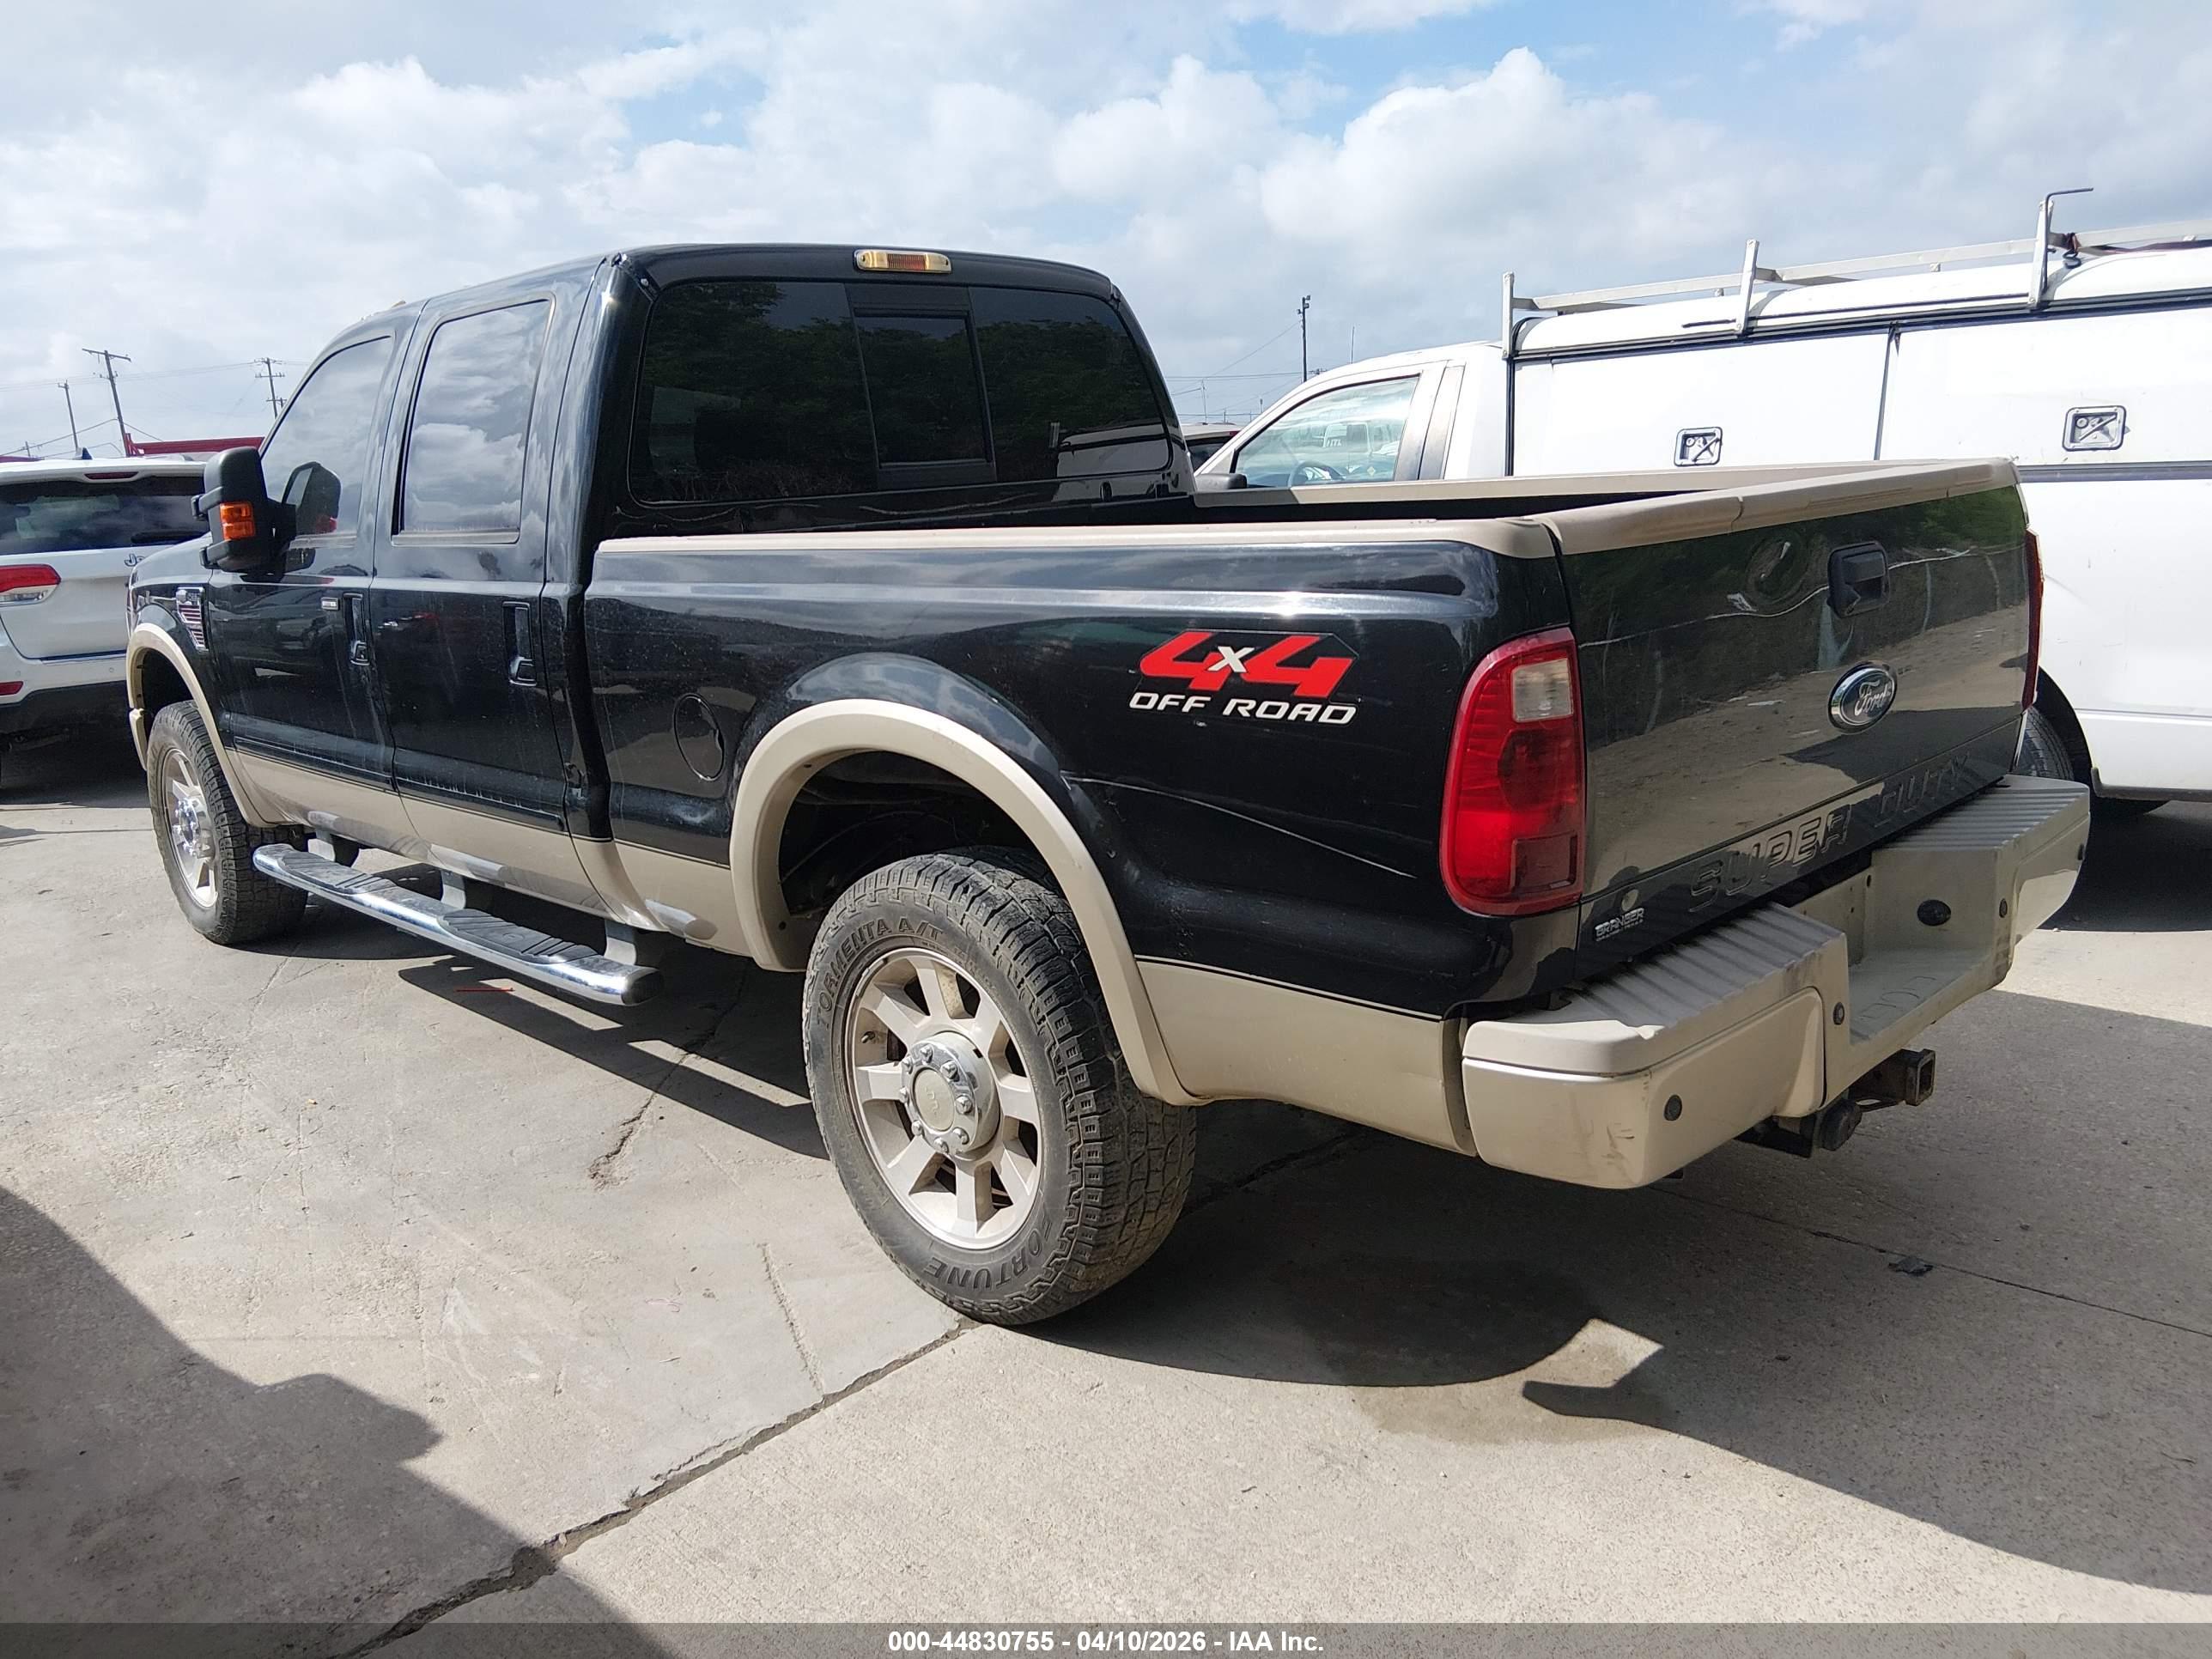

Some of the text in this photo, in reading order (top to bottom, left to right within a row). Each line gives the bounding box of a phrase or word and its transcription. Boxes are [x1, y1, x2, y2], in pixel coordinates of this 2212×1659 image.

[1128, 692, 1357, 725] OFF ROAD
[1688, 804, 1851, 912] SUPER
[817, 918, 893, 1030] TORMENTA
[898, 917, 944, 941] A/T
[923, 1218, 1054, 1290] FORTUNE
